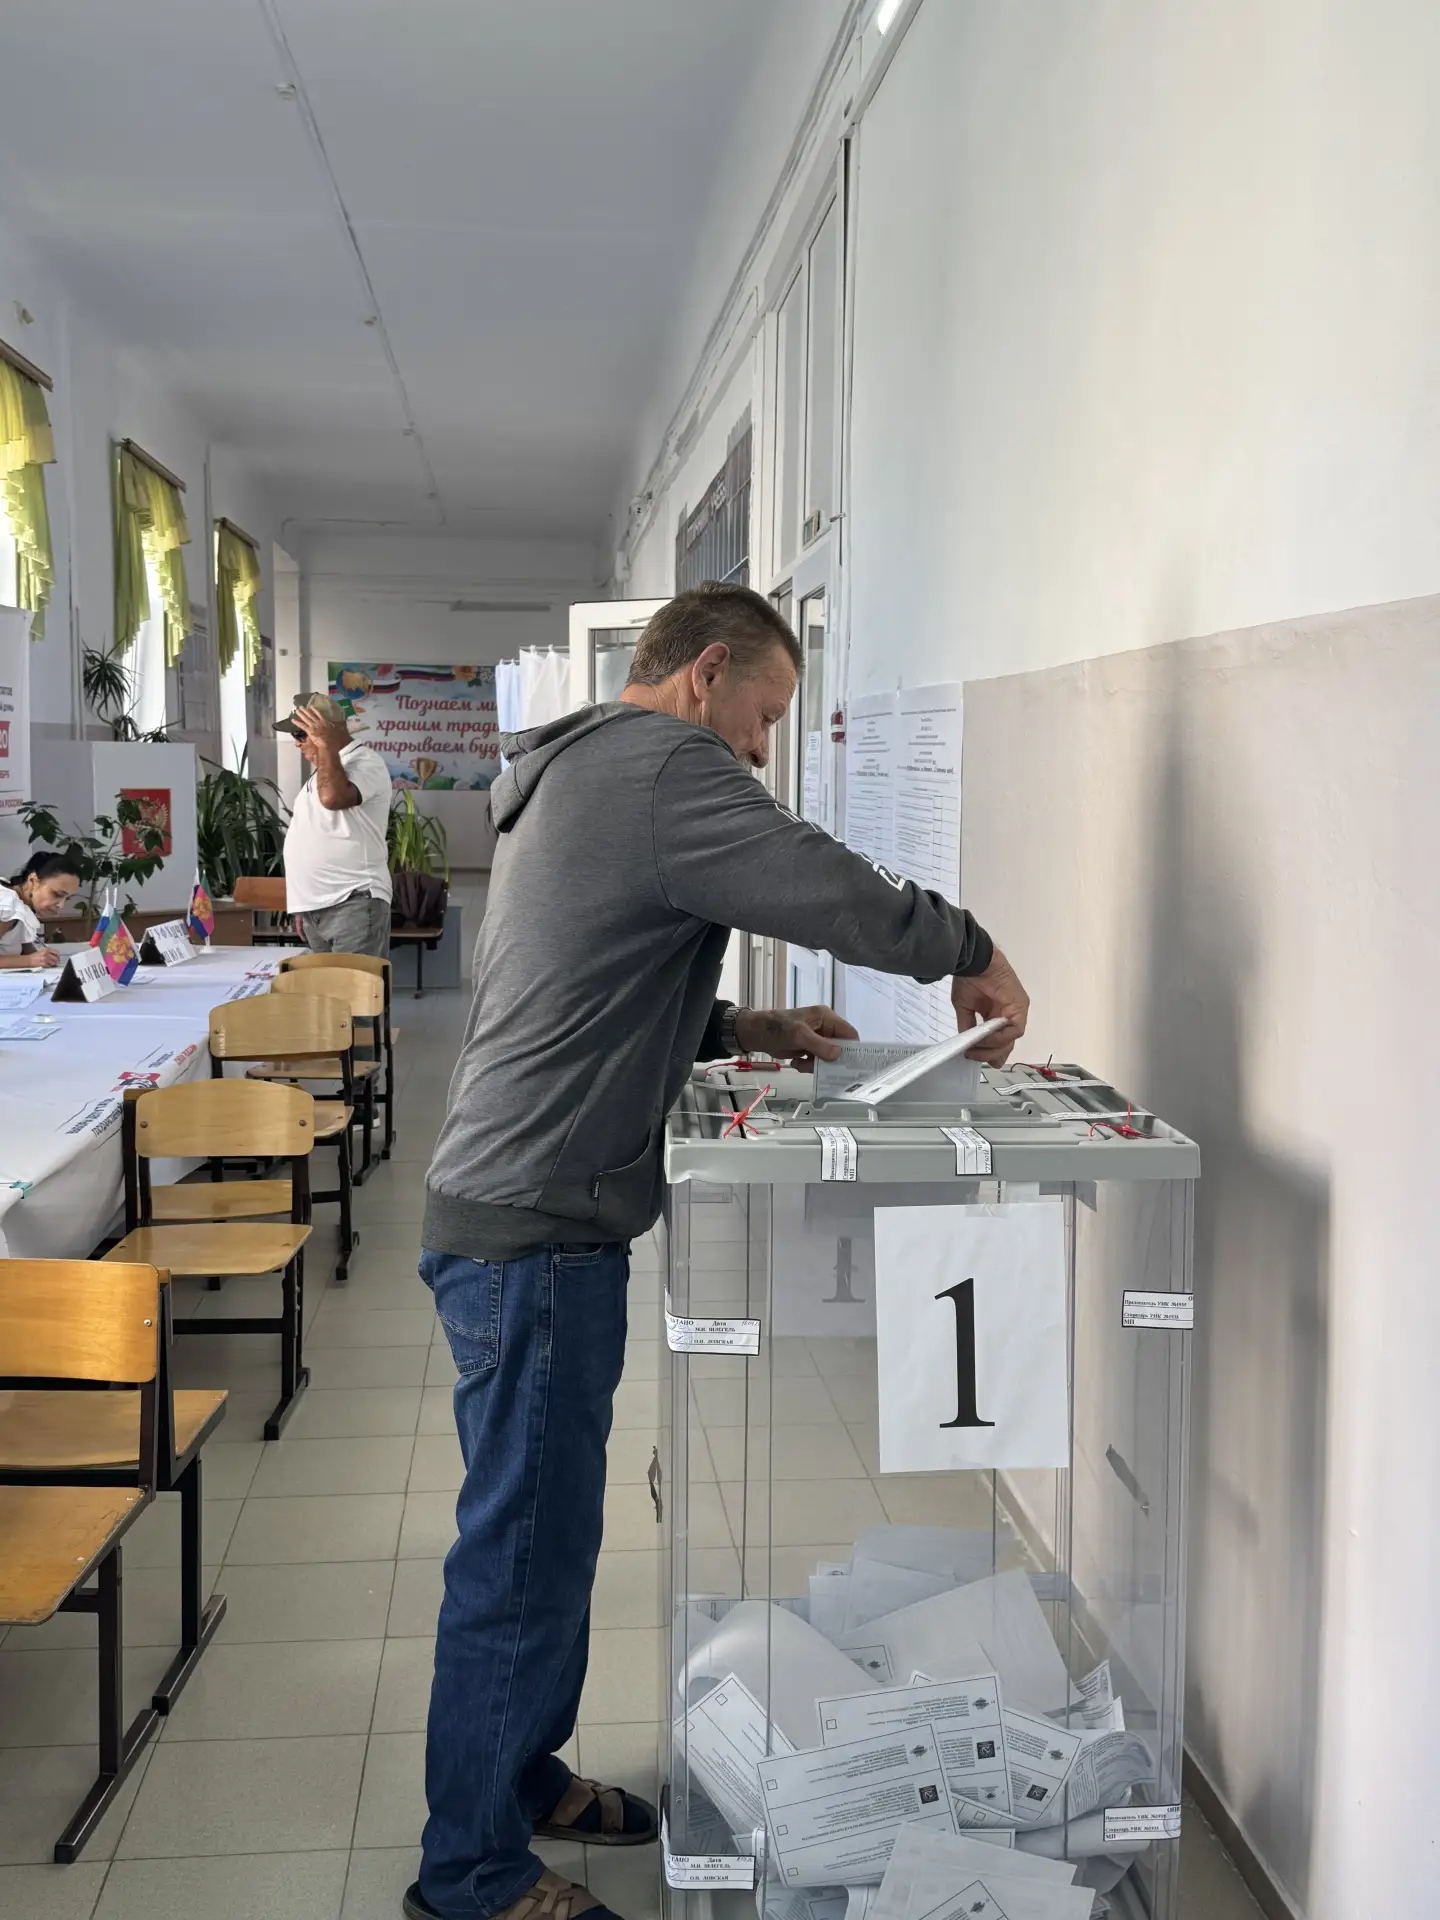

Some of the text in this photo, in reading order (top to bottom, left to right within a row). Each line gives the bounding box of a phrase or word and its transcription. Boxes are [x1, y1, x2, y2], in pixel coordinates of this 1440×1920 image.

[395, 694, 472, 716] Познаем
[376, 719, 442, 737] храним
[365, 736, 465, 758] открываем
[934, 1278, 995, 1428] 1
